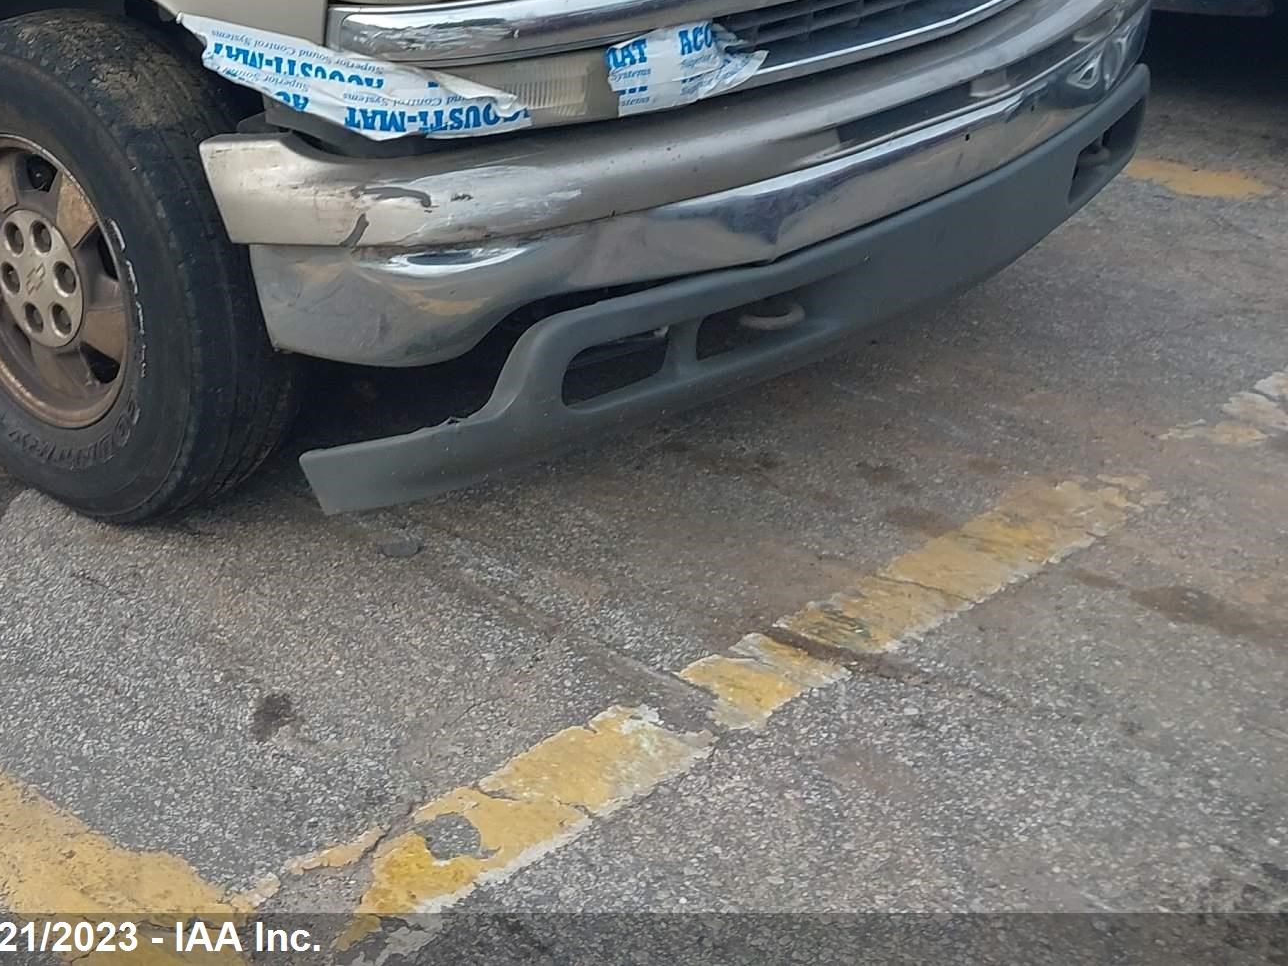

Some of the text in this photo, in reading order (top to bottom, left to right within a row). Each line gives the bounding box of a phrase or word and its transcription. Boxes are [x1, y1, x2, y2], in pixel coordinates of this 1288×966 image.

[212, 29, 252, 47] Systems
[253, 39, 297, 57] Control
[334, 57, 385, 75] Superior
[263, 73, 310, 92] Superior
[343, 92, 391, 107] Systems
